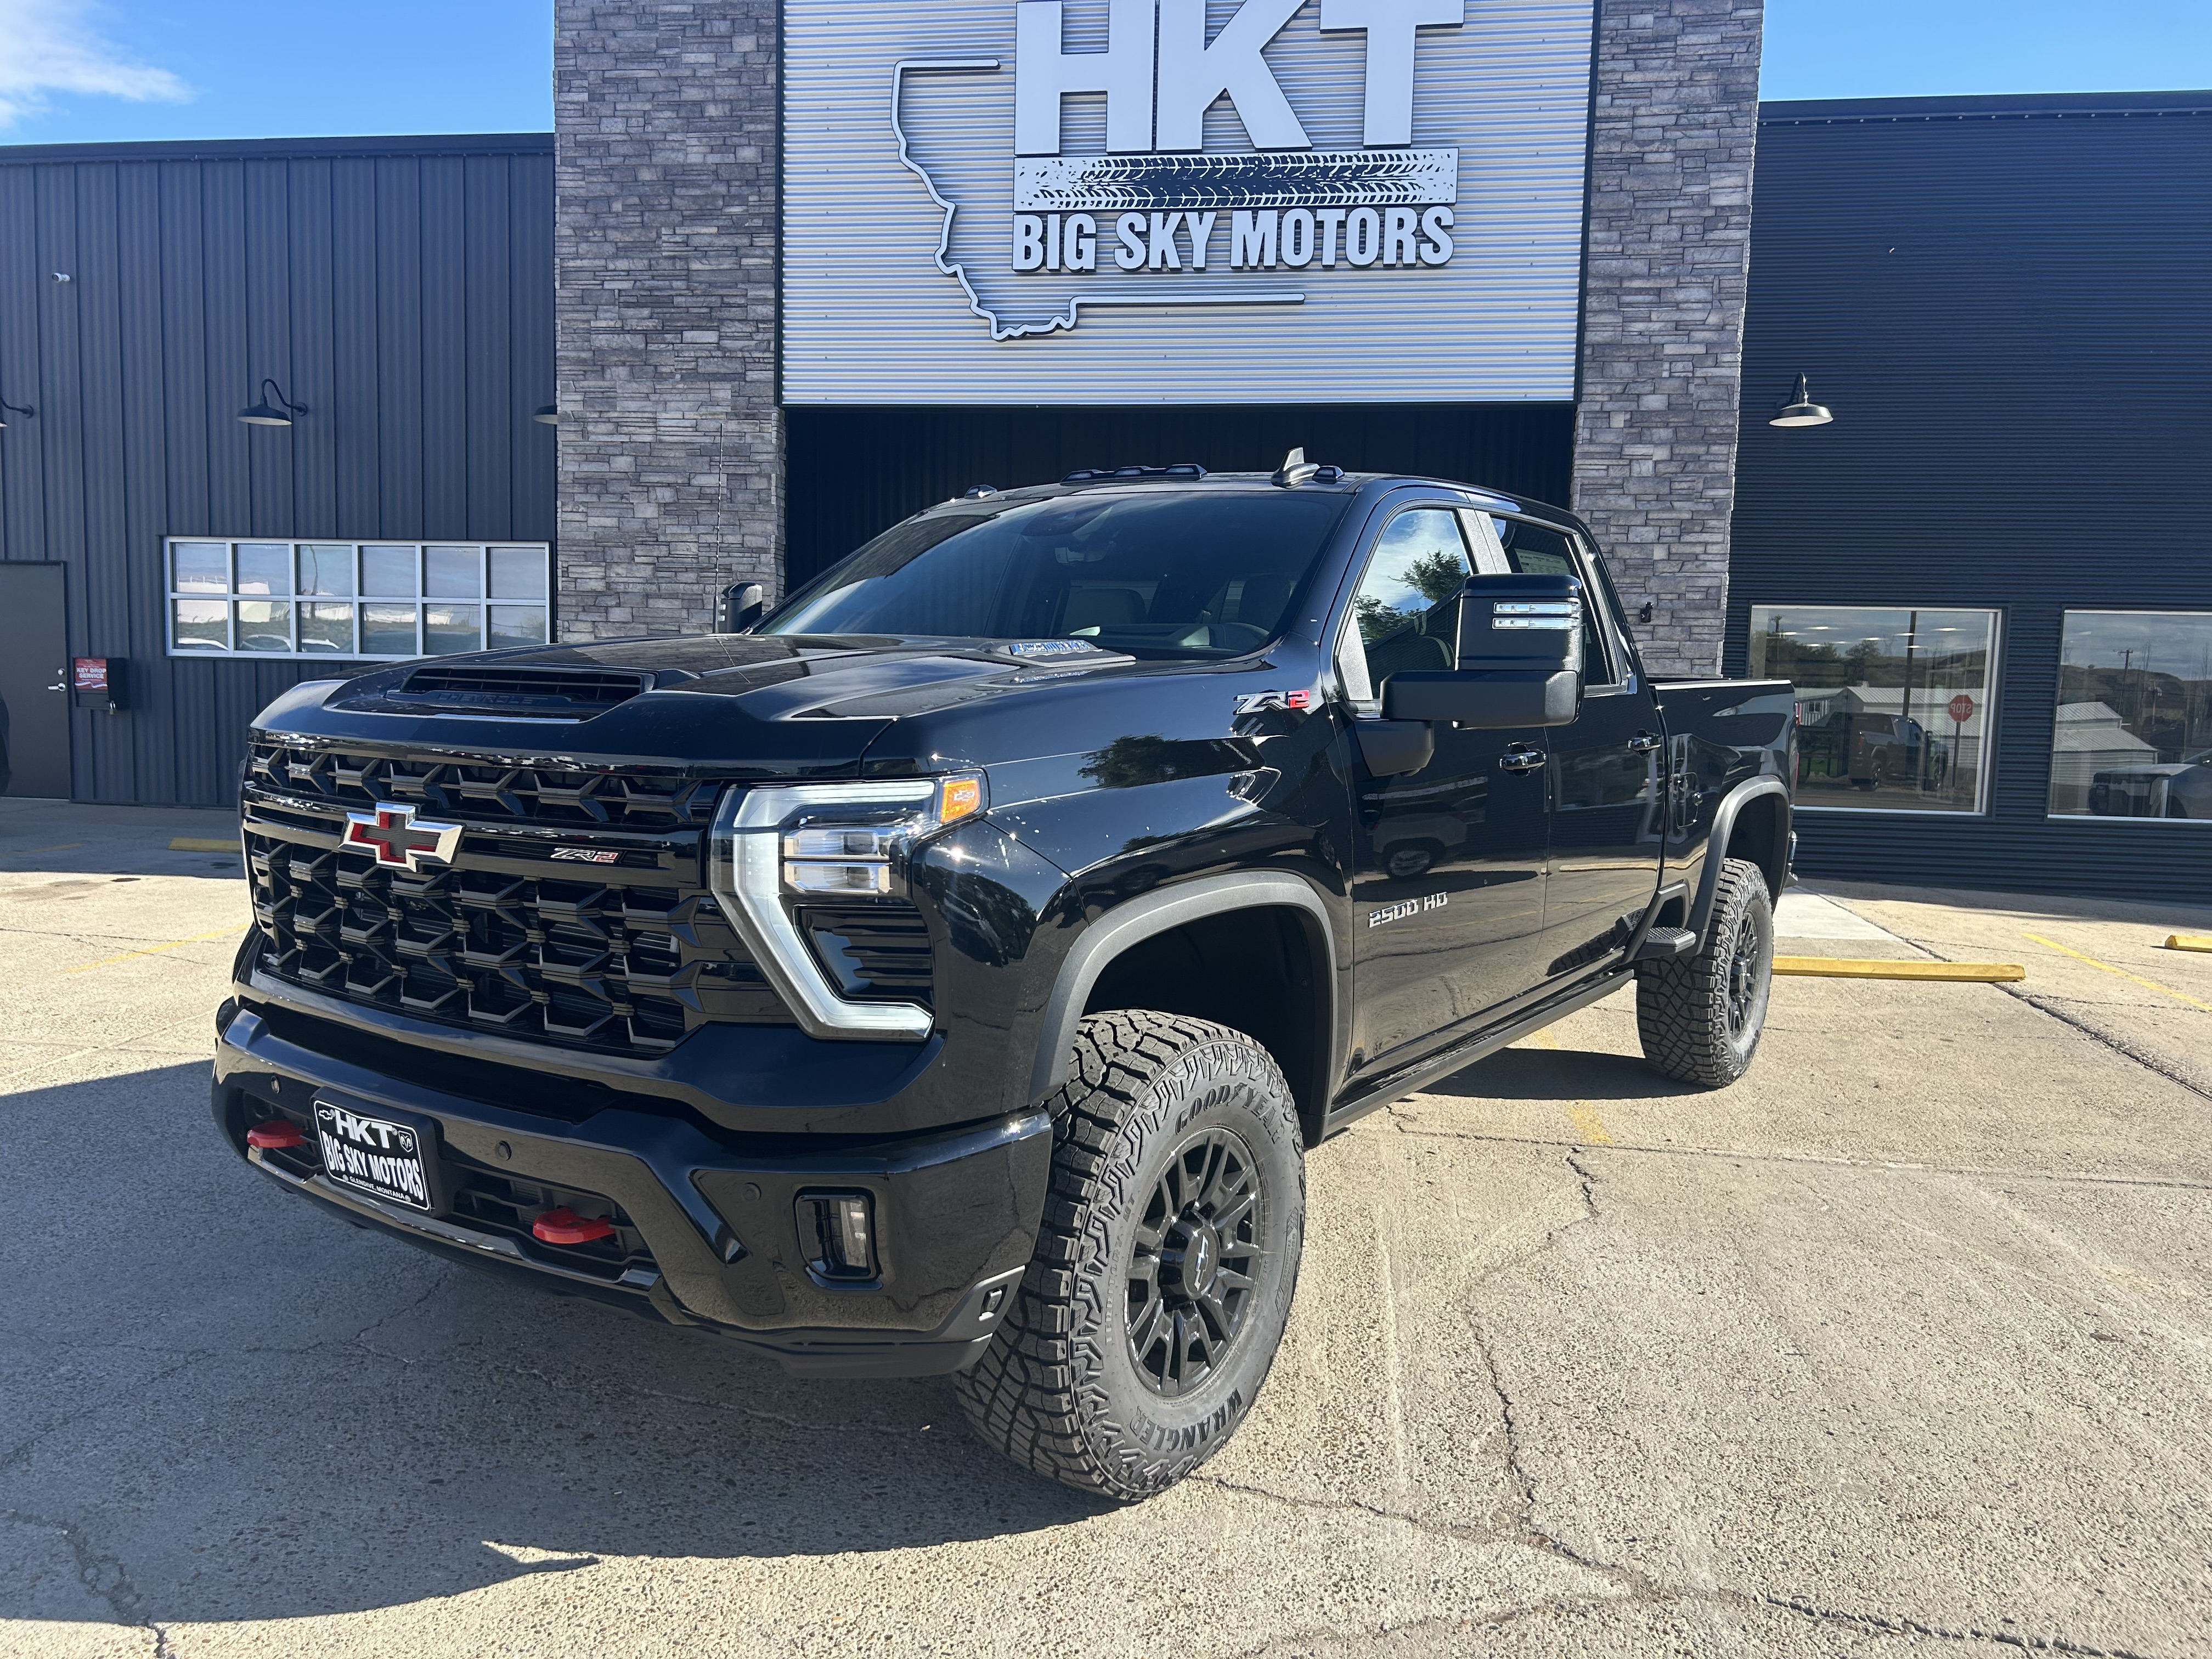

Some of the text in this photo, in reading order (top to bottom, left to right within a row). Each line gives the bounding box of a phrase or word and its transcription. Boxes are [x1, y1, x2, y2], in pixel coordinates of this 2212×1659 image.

[1014, 0, 1465, 156] HKT
[1012, 206, 1455, 272] BIG SKY MOTORS
[1233, 690, 1310, 715] ZR2
[550, 848, 619, 863] ZR2
[1368, 891, 1448, 928] 2500 HD
[335, 1109, 393, 1149] HKT
[321, 1130, 424, 1200] BIG SKY MOTORS
[349, 1176, 405, 1199] GLENDIVE, MONTANA
[1105, 1235, 1122, 1345] TERRITORY
[1130, 1387, 1243, 1453] WRANGLER
